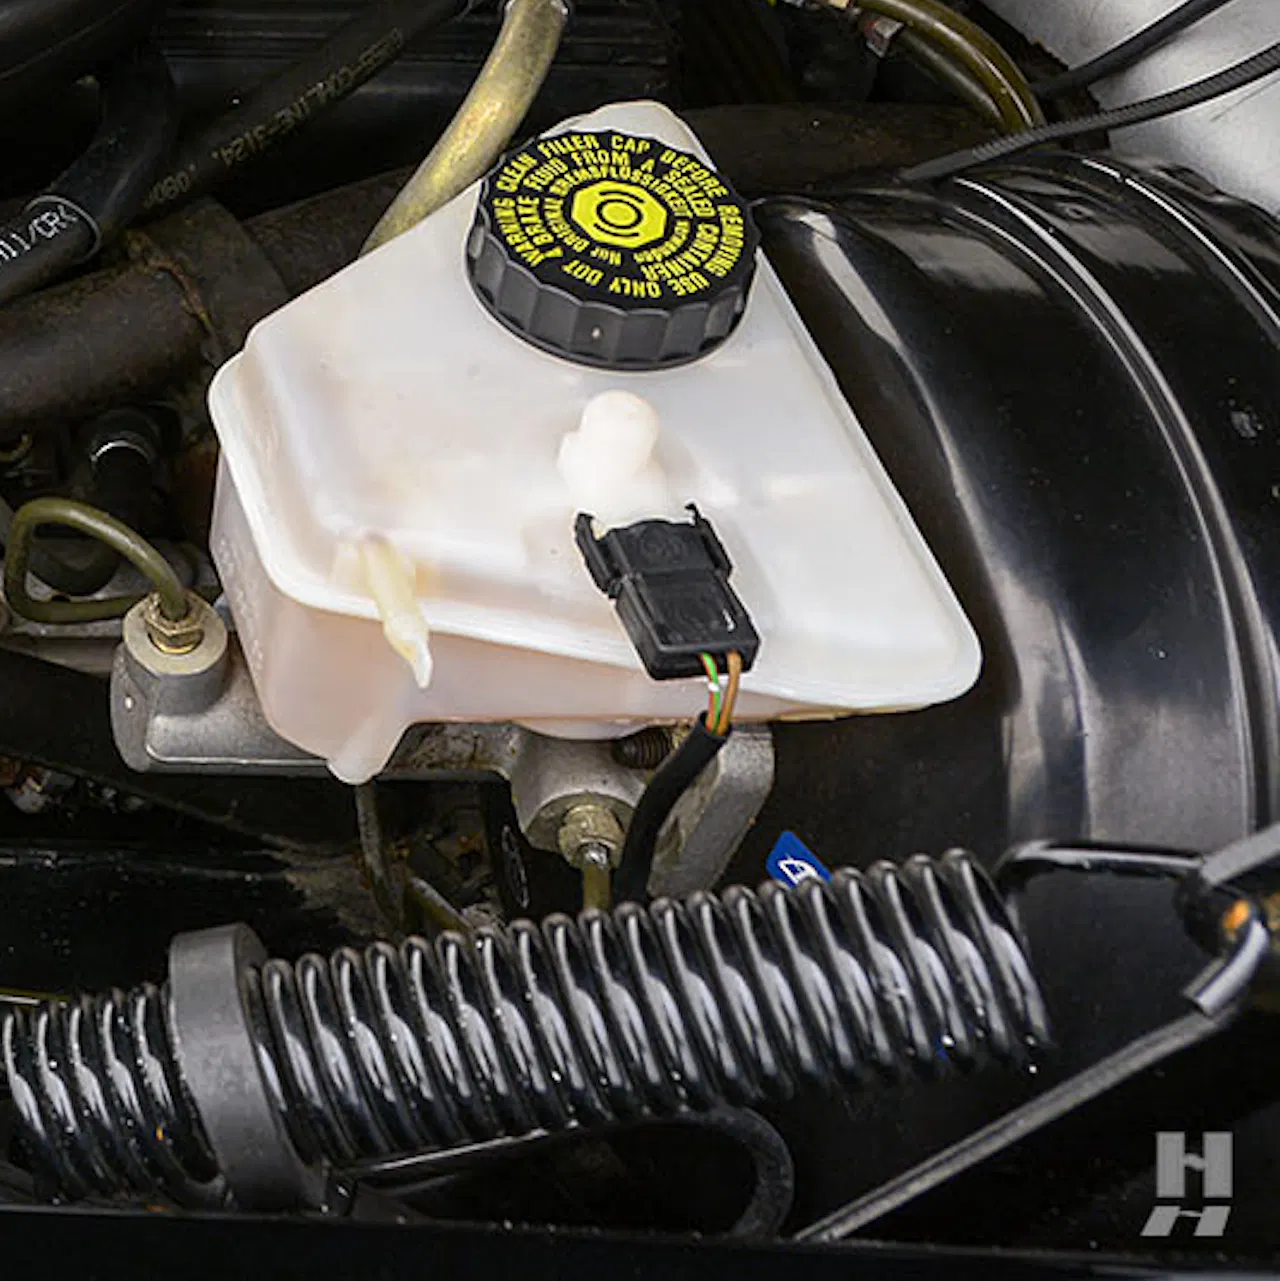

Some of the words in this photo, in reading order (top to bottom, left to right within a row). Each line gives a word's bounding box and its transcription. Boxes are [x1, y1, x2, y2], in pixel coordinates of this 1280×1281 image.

[537, 134, 600, 160] FILLER
[571, 149, 631, 167] FROM
[611, 134, 651, 154] CAP
[496, 152, 538, 193] CLEAN
[523, 157, 569, 192] FLUID
[640, 158, 656, 173] A
[660, 149, 730, 198] BEFORE
[662, 168, 717, 218] SEALED
[516, 195, 555, 246] BRAKE
[640, 221, 720, 281] CONTAINER
[703, 204, 744, 277] REMOVING
[561, 259, 604, 286] DOT
[608, 276, 662, 298] ONLY
[667, 271, 710, 297] USE
